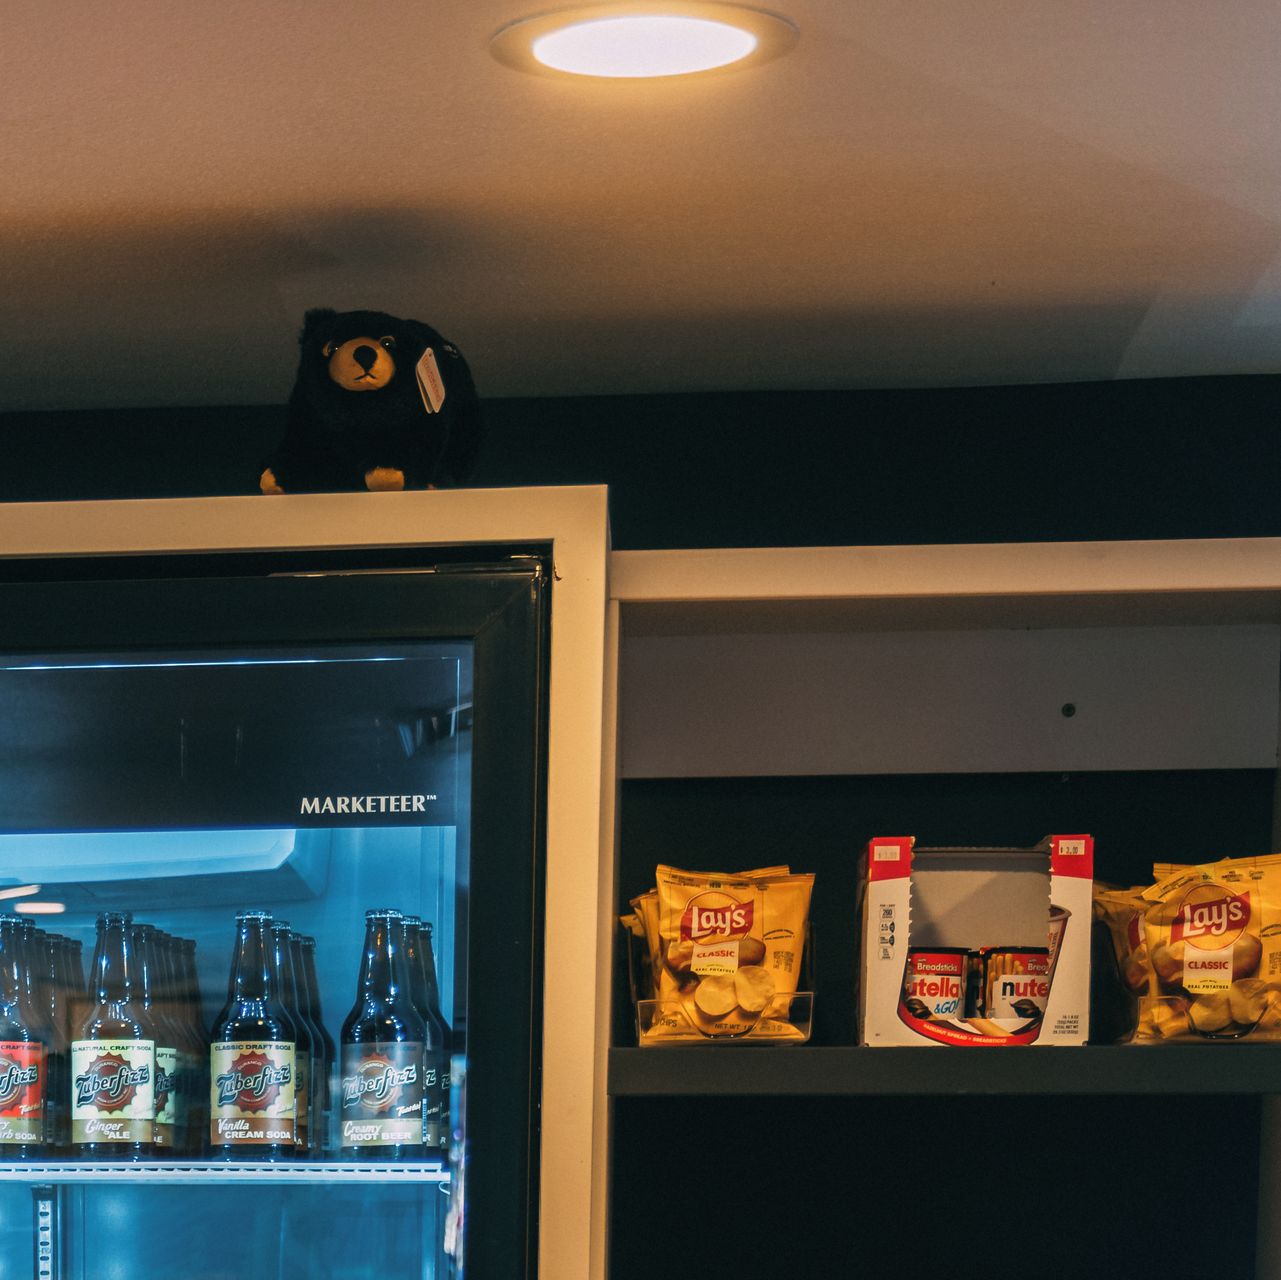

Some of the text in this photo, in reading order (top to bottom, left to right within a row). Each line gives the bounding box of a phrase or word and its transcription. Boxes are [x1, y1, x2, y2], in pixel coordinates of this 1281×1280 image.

[692, 905, 746, 937] Lay's
[1183, 897, 1242, 937] Lay's
[697, 950, 735, 958] CLASSIC
[917, 963, 957, 972] Breadsticks
[1188, 961, 1228, 970] CLASSIC
[906, 978, 959, 998] utella
[934, 1000, 960, 1014] &GO!
[76, 1064, 150, 1107] Zuberfizz
[216, 1063, 290, 1107] Zuberfizz
[343, 1063, 417, 1108] Zuberfizz
[85, 1119, 124, 1135] Ginger
[218, 1119, 250, 1134] Vanilla
[344, 1121, 381, 1137] Creamy
[225, 1131, 263, 1139] CREAM
[350, 1132, 412, 1141] ROOT BEER
